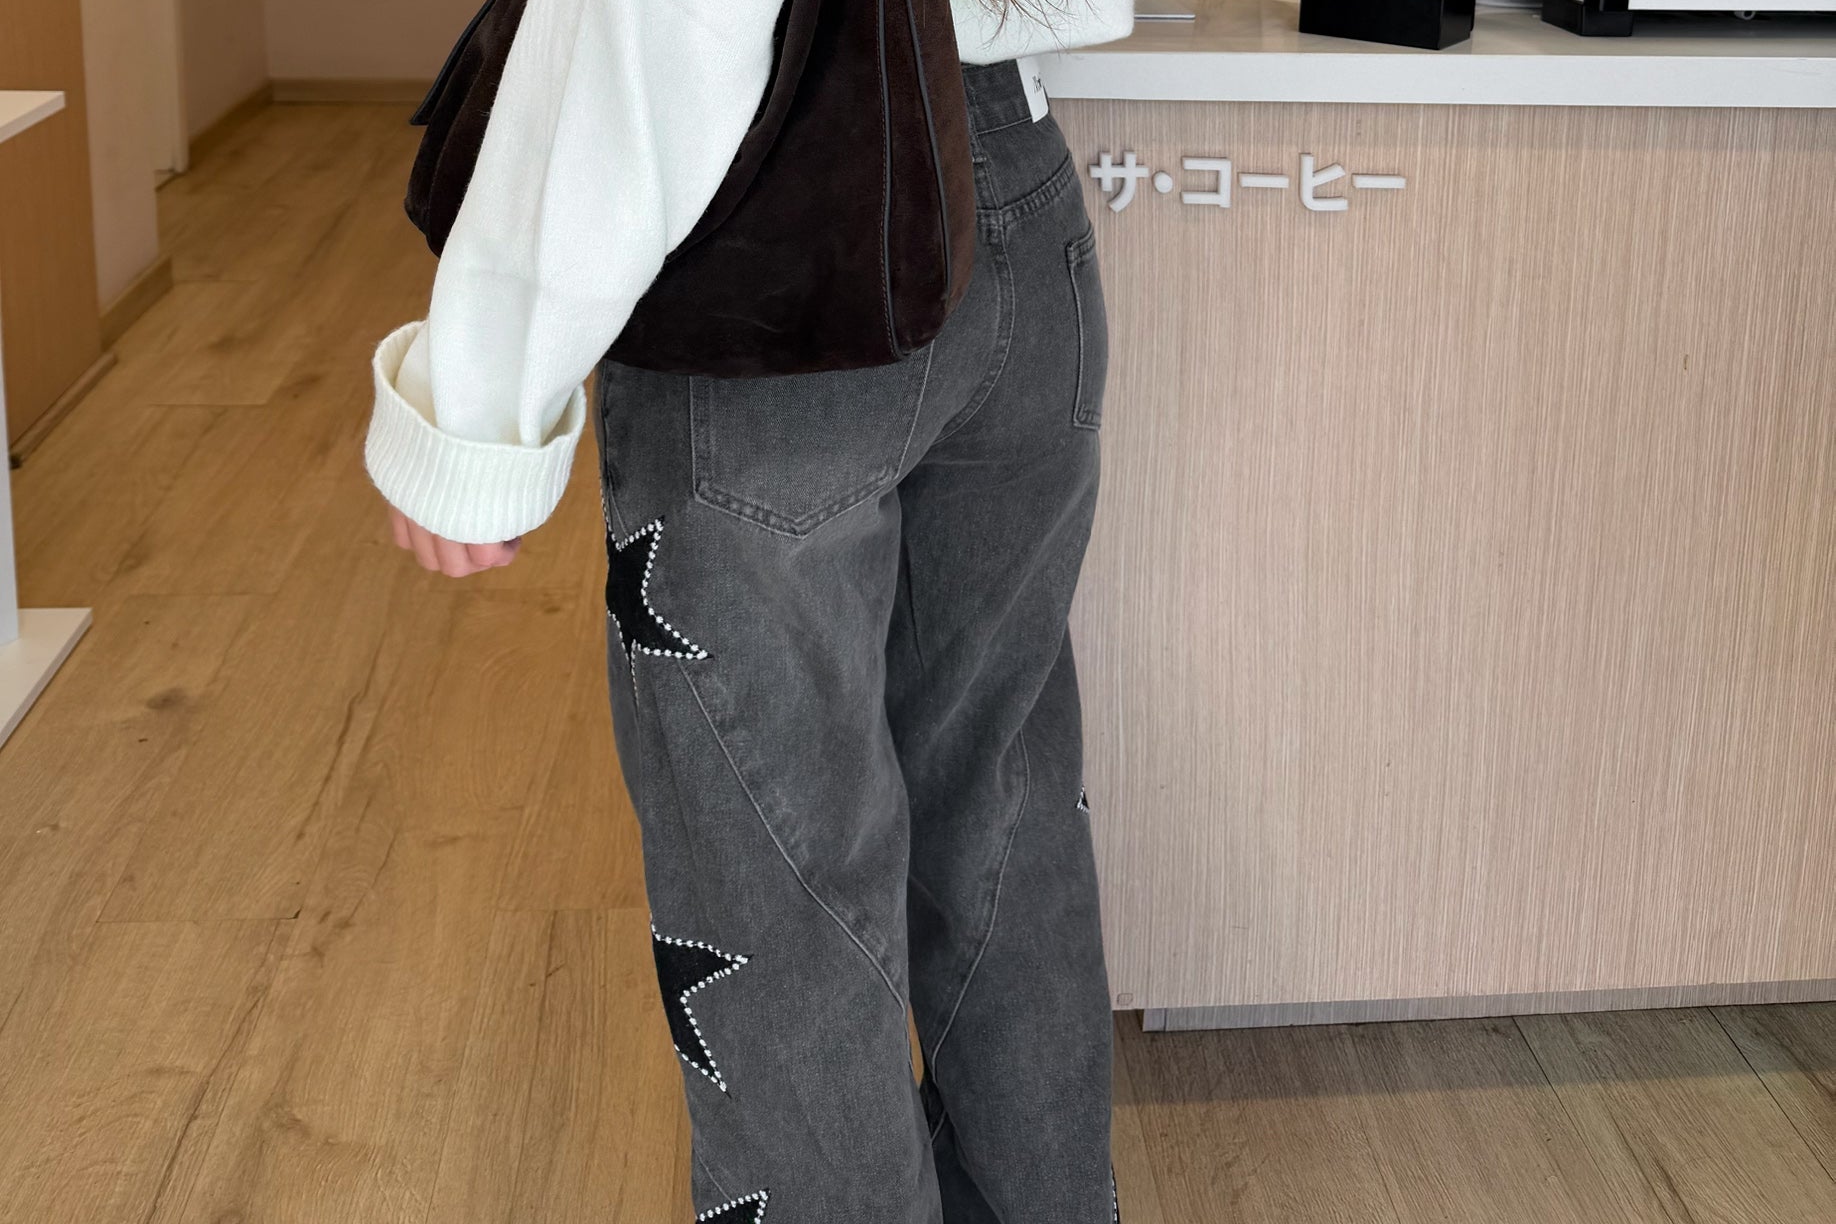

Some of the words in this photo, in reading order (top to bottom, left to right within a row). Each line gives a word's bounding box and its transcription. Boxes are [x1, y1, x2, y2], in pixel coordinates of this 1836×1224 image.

[1088, 151, 1406, 213] ザ・コーヒー
